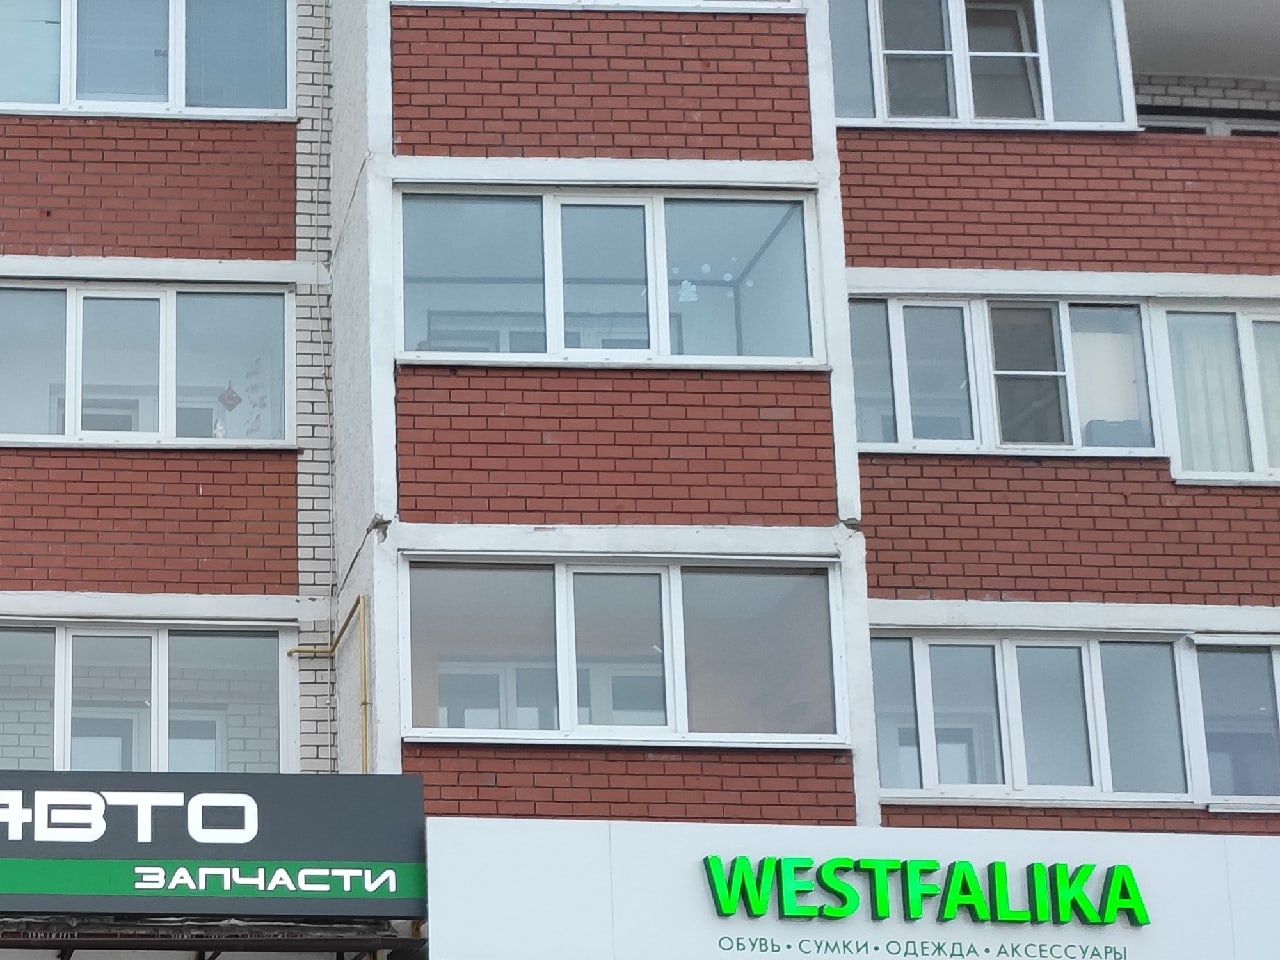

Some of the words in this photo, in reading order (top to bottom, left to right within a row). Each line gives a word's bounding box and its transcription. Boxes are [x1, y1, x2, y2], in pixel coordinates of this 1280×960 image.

[133, 866, 398, 893] ЗАПЧАСТИ
[702, 854, 1150, 926] WESTFALIKA
[718, 935, 781, 954] ОБУВЬ
[798, 939, 870, 958] СУМКИ
[885, 940, 980, 960] ОДЕЖДА
